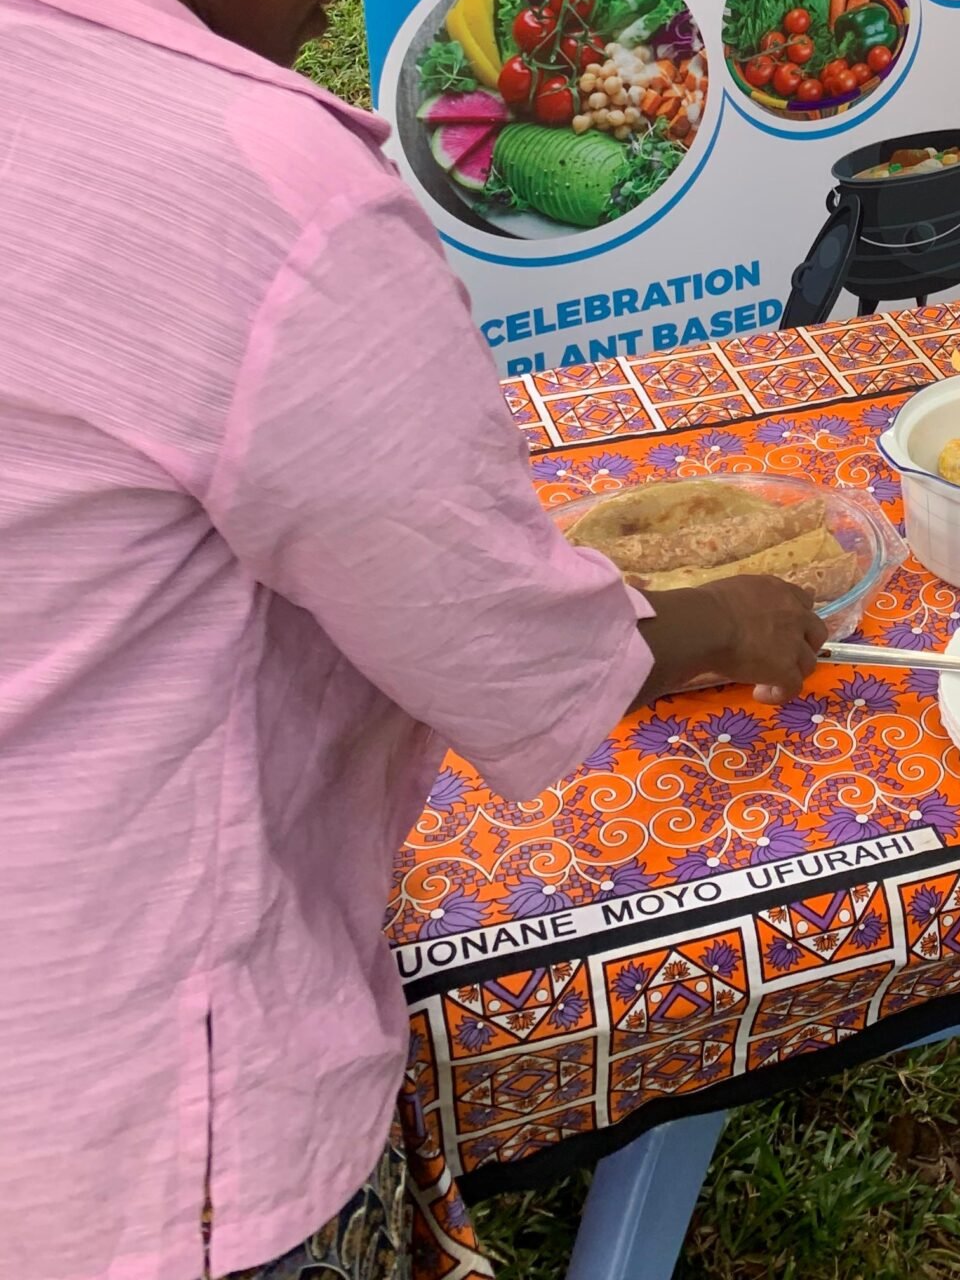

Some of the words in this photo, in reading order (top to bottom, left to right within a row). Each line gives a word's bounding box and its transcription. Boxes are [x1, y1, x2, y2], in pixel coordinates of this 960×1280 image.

[479, 260, 762, 348] CELEBRATION
[652, 298, 784, 352] BASED
[601, 881, 722, 926] MOYO
[745, 834, 915, 890] UFURAHI
